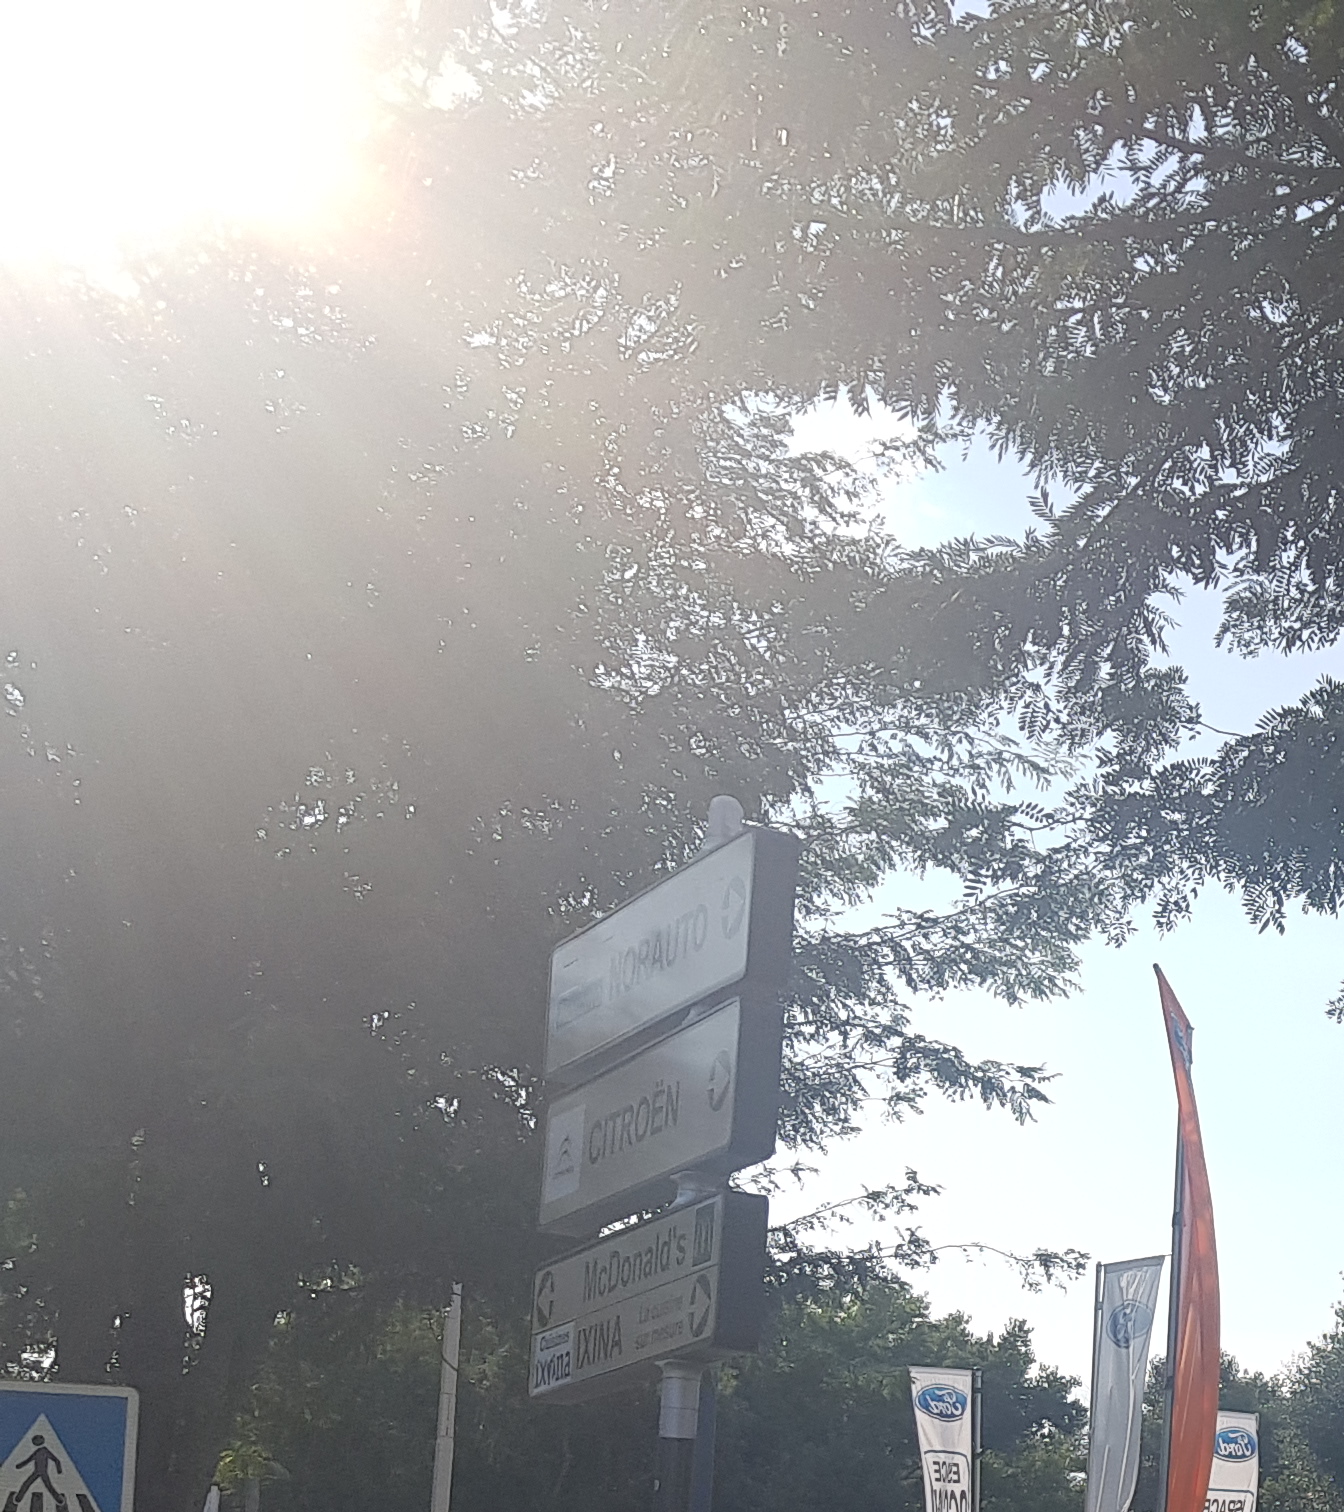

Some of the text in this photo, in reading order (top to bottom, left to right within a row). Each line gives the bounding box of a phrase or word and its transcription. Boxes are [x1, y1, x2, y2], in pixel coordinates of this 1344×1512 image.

[609, 903, 708, 1000] NORAUTO
[588, 1079, 680, 1165] CITROËN
[583, 1225, 687, 1302] McDonald's
[576, 1315, 622, 1370] IXINA
